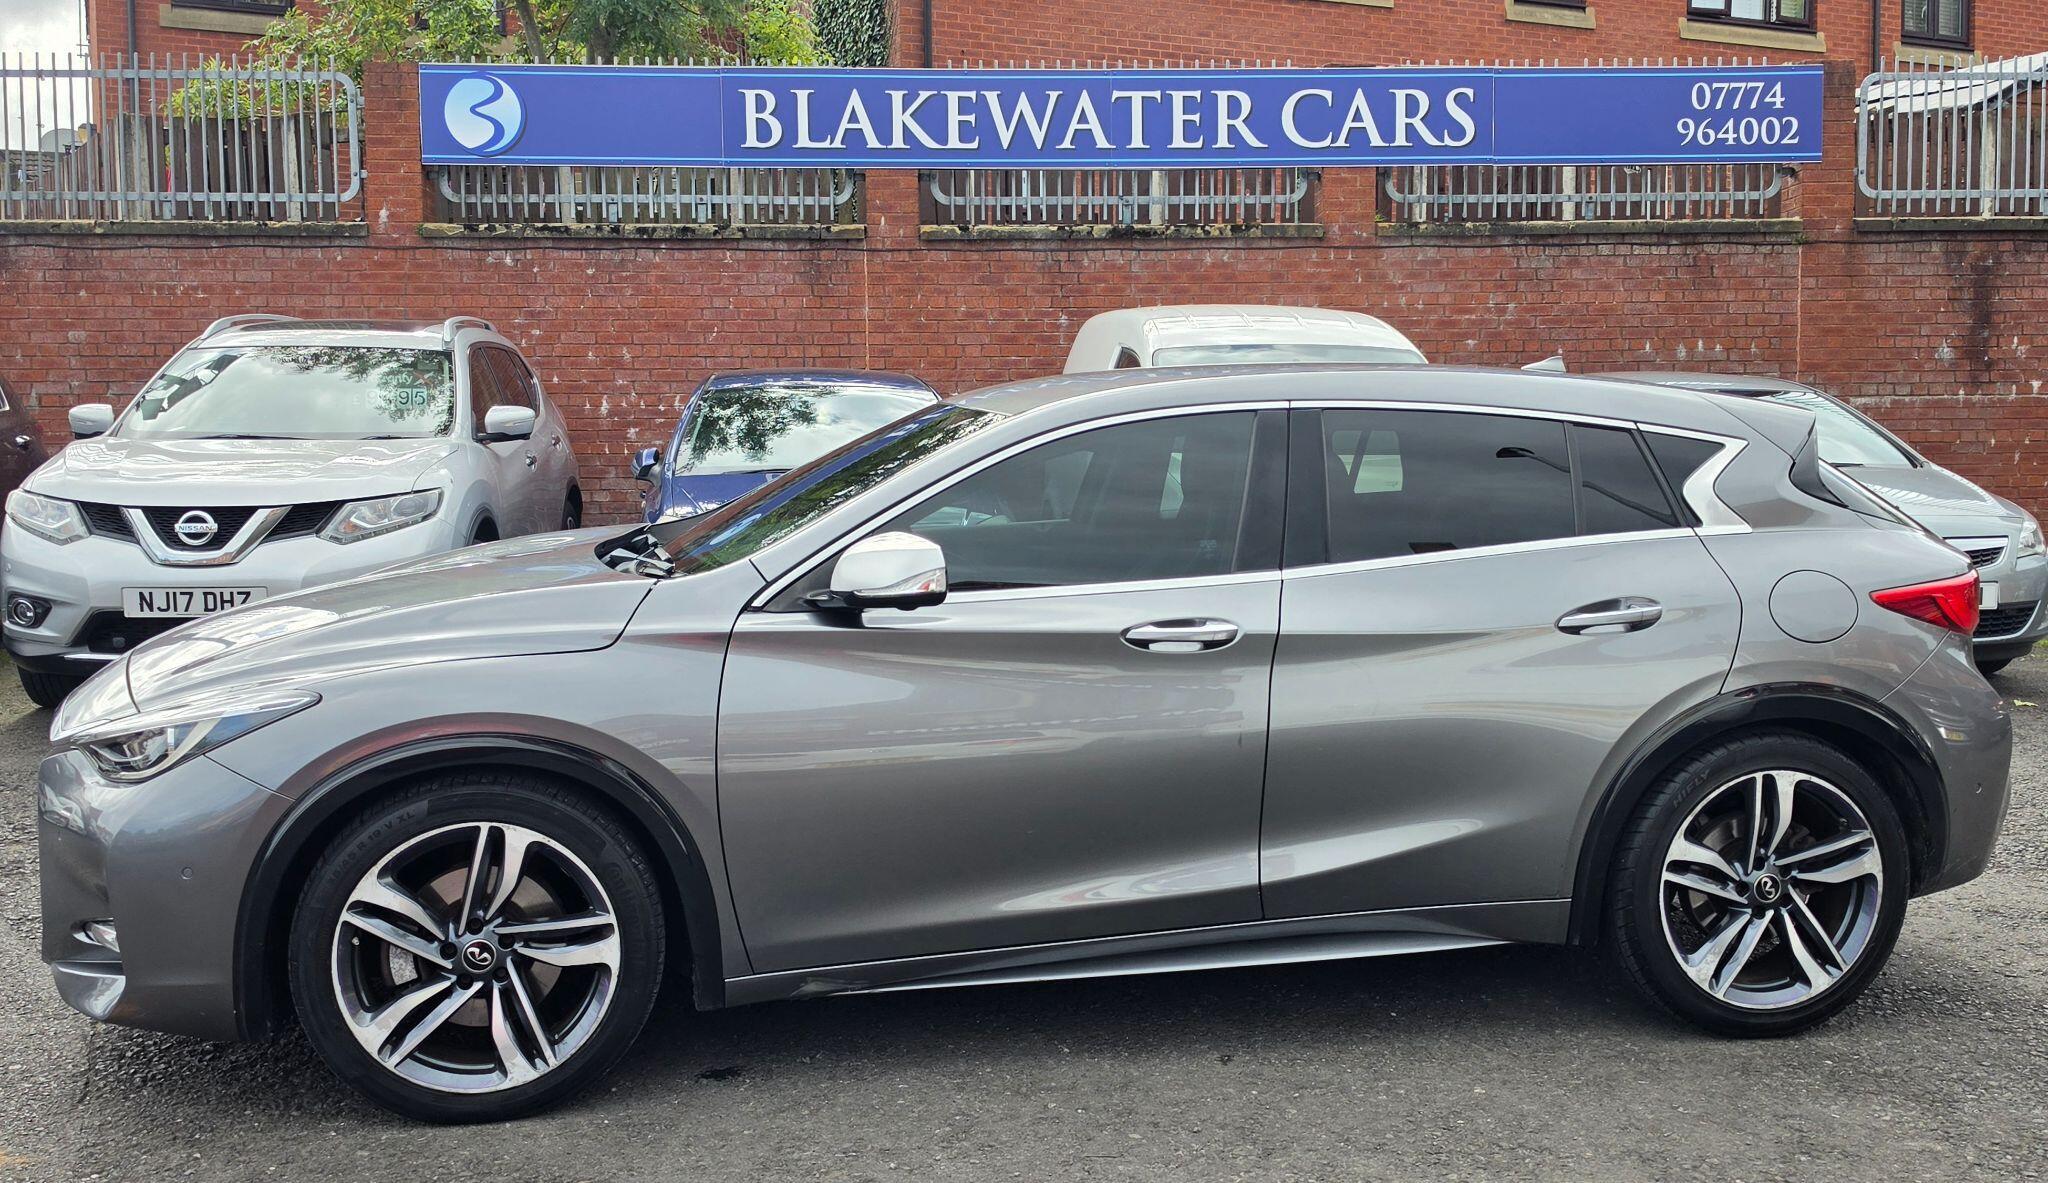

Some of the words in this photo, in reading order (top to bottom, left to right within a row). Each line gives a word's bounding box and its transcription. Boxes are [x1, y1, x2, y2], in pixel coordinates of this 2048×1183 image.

[1691, 81, 1785, 110] 07774
[738, 88, 1268, 149] BLAKEWATER
[1281, 87, 1475, 148] CARS
[1676, 116, 1800, 146] 964002
[138, 591, 194, 612] NJ17
